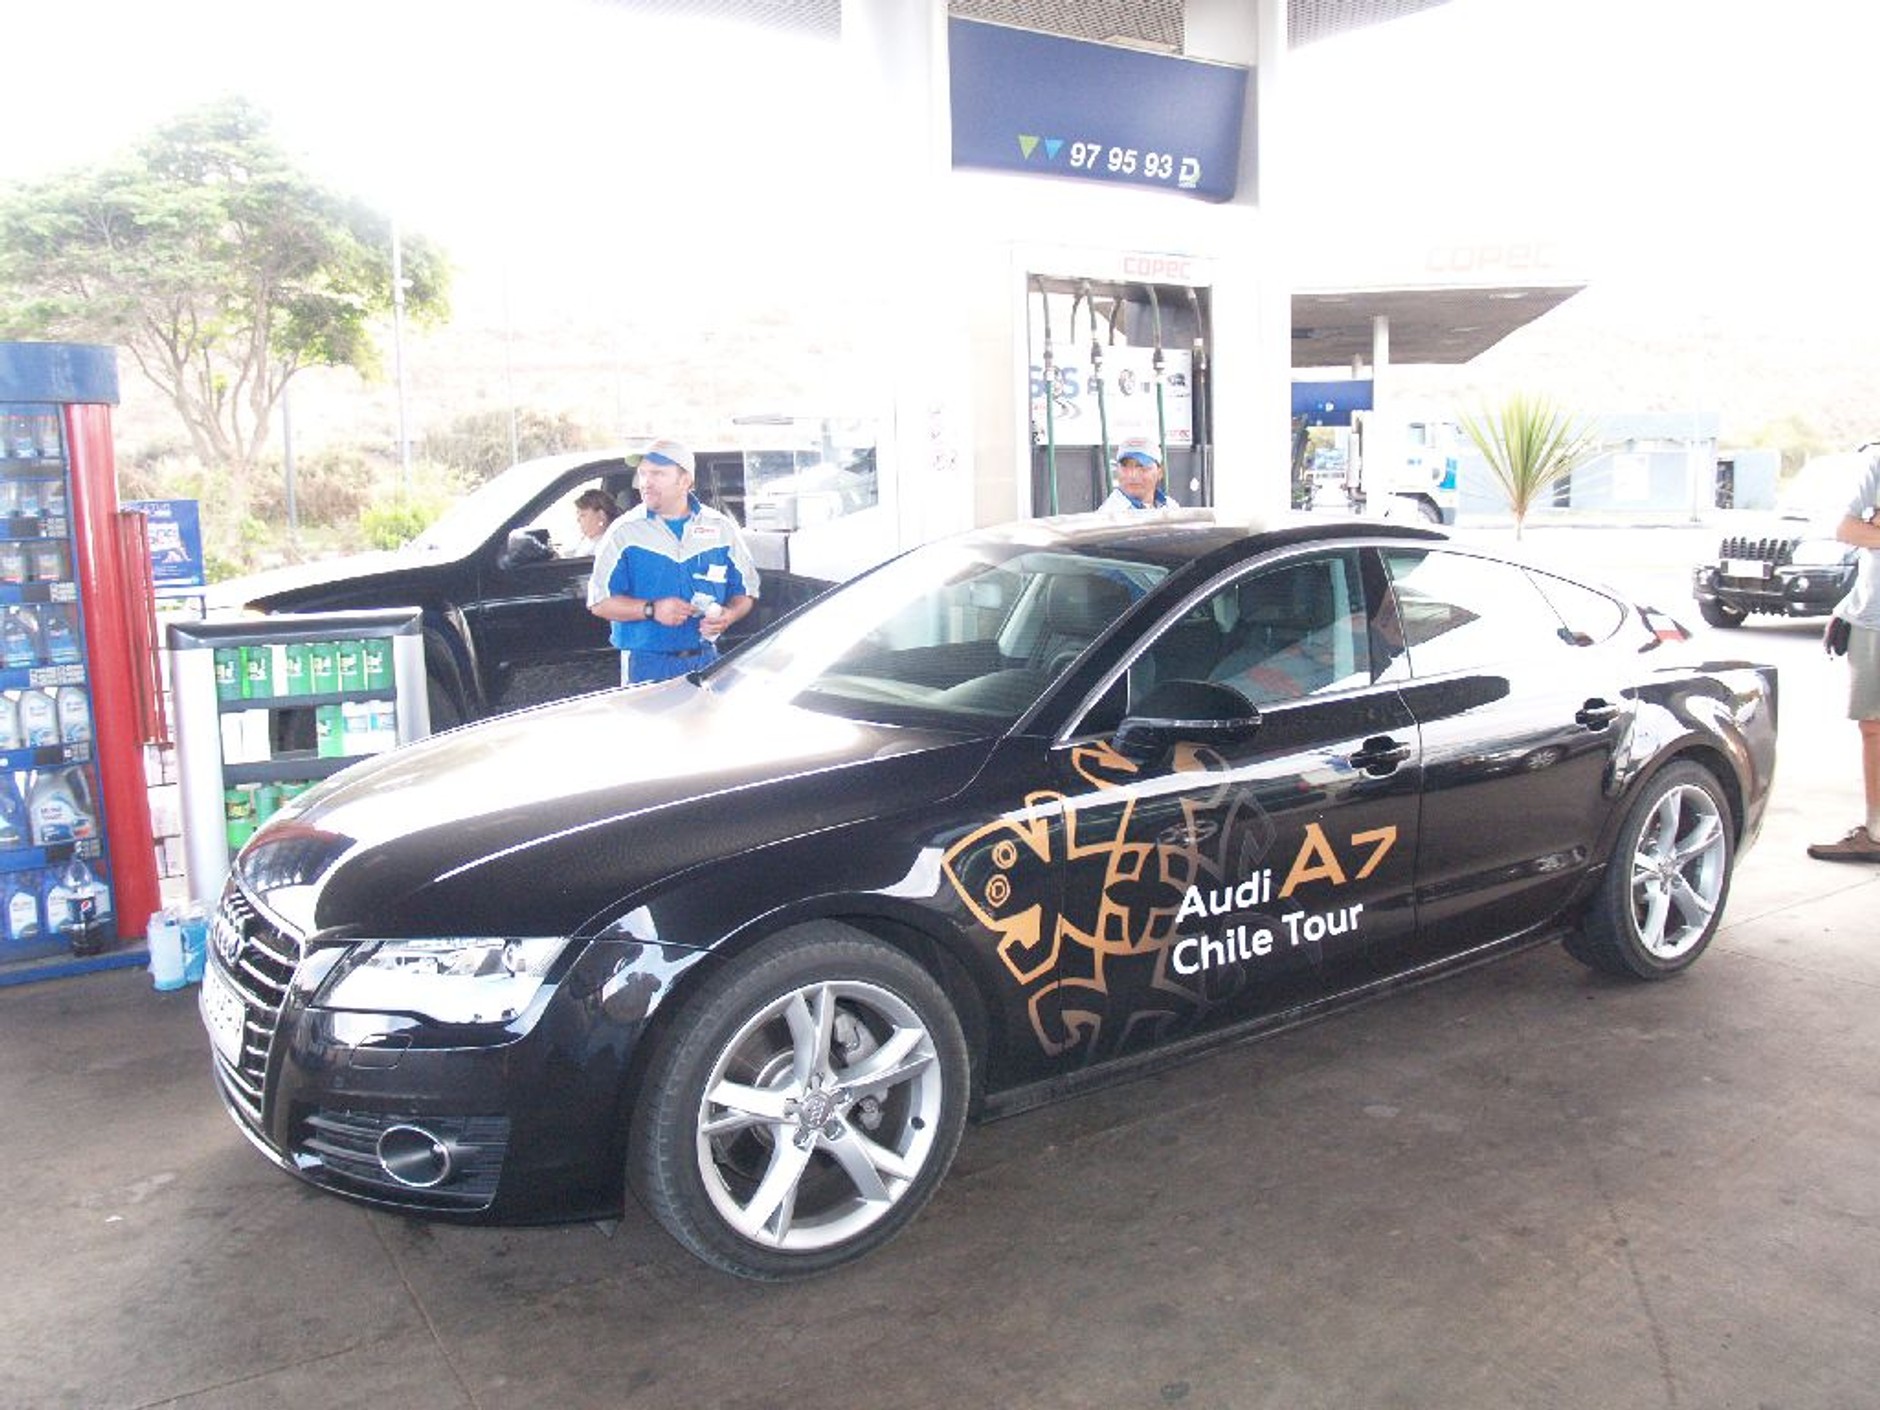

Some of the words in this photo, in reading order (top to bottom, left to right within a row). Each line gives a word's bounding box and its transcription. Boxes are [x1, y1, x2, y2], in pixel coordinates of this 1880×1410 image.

[1070, 142, 1102, 170] 97
[1107, 147, 1138, 174] 95
[1144, 152, 1173, 179] 93
[1175, 868, 1272, 924] Audi
[1278, 822, 1397, 899] A7
[1172, 925, 1274, 975] Chile
[1281, 903, 1364, 946] Tour
